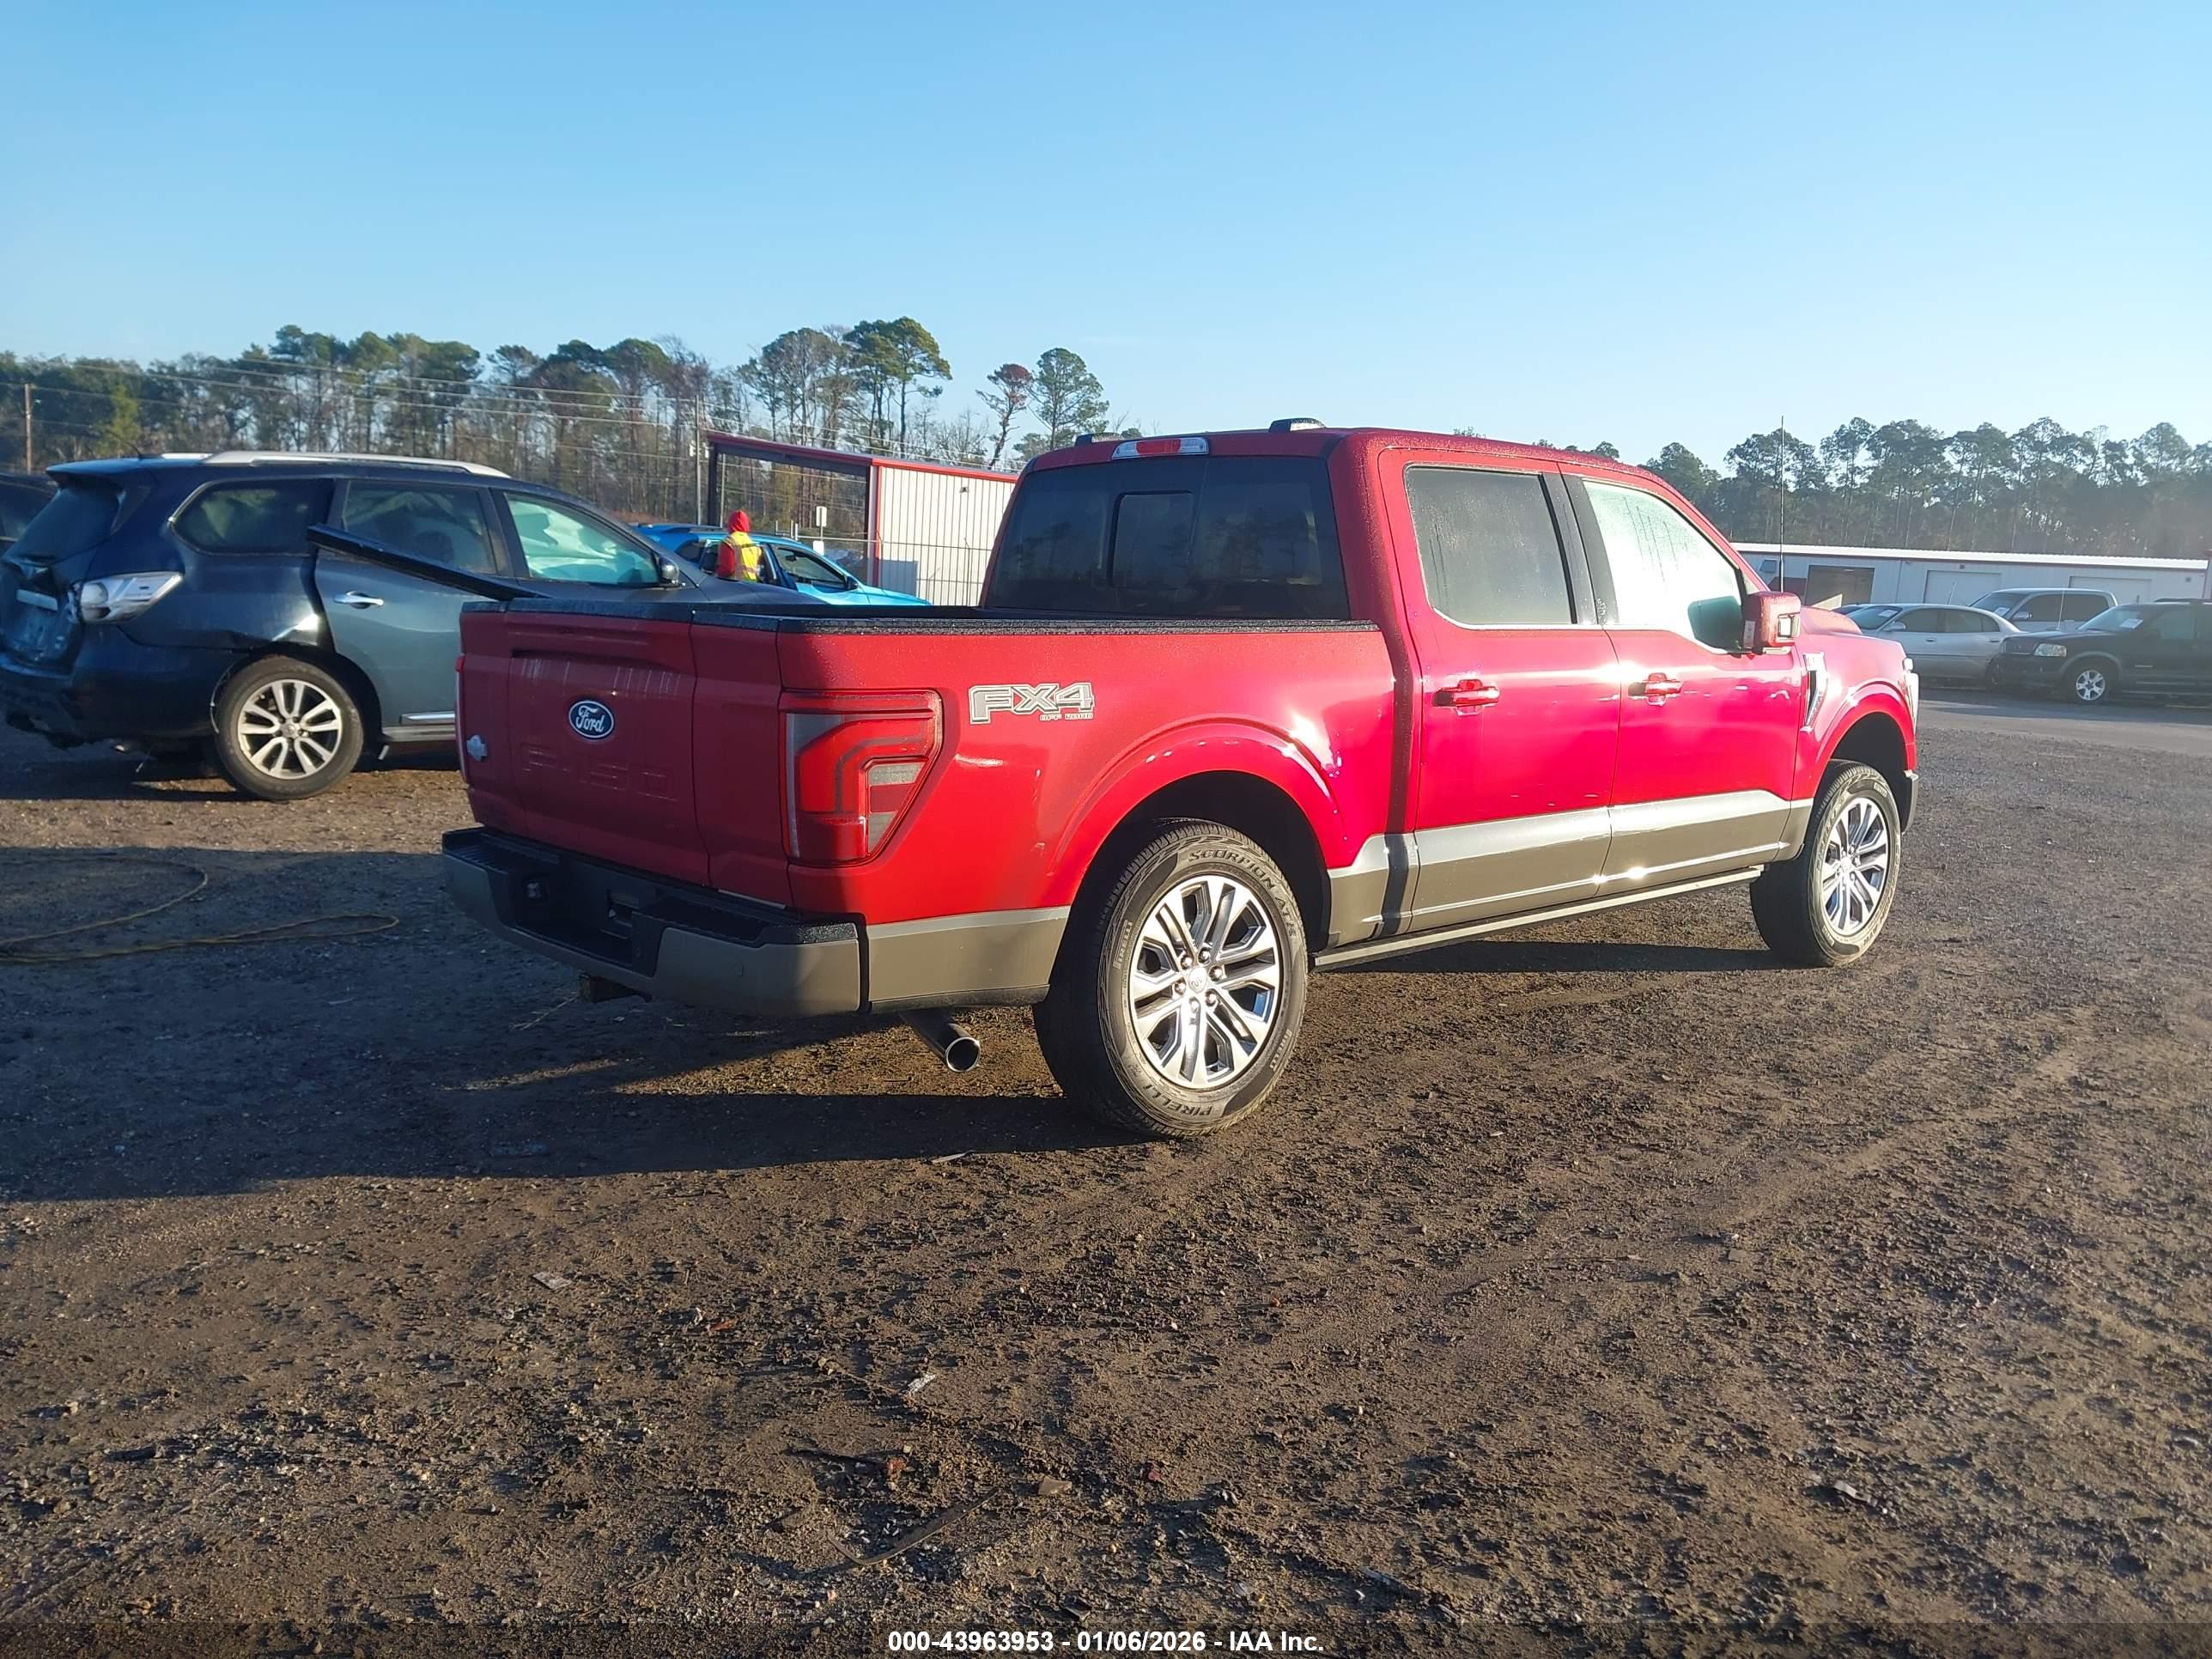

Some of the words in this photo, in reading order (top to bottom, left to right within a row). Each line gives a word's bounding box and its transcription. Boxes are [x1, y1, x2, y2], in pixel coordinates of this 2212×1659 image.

[574, 704, 606, 733] Ford
[969, 683, 1095, 724] FX4
[1188, 849, 1276, 890] SCORPION
[1142, 1084, 1213, 1116] PIRELLI
